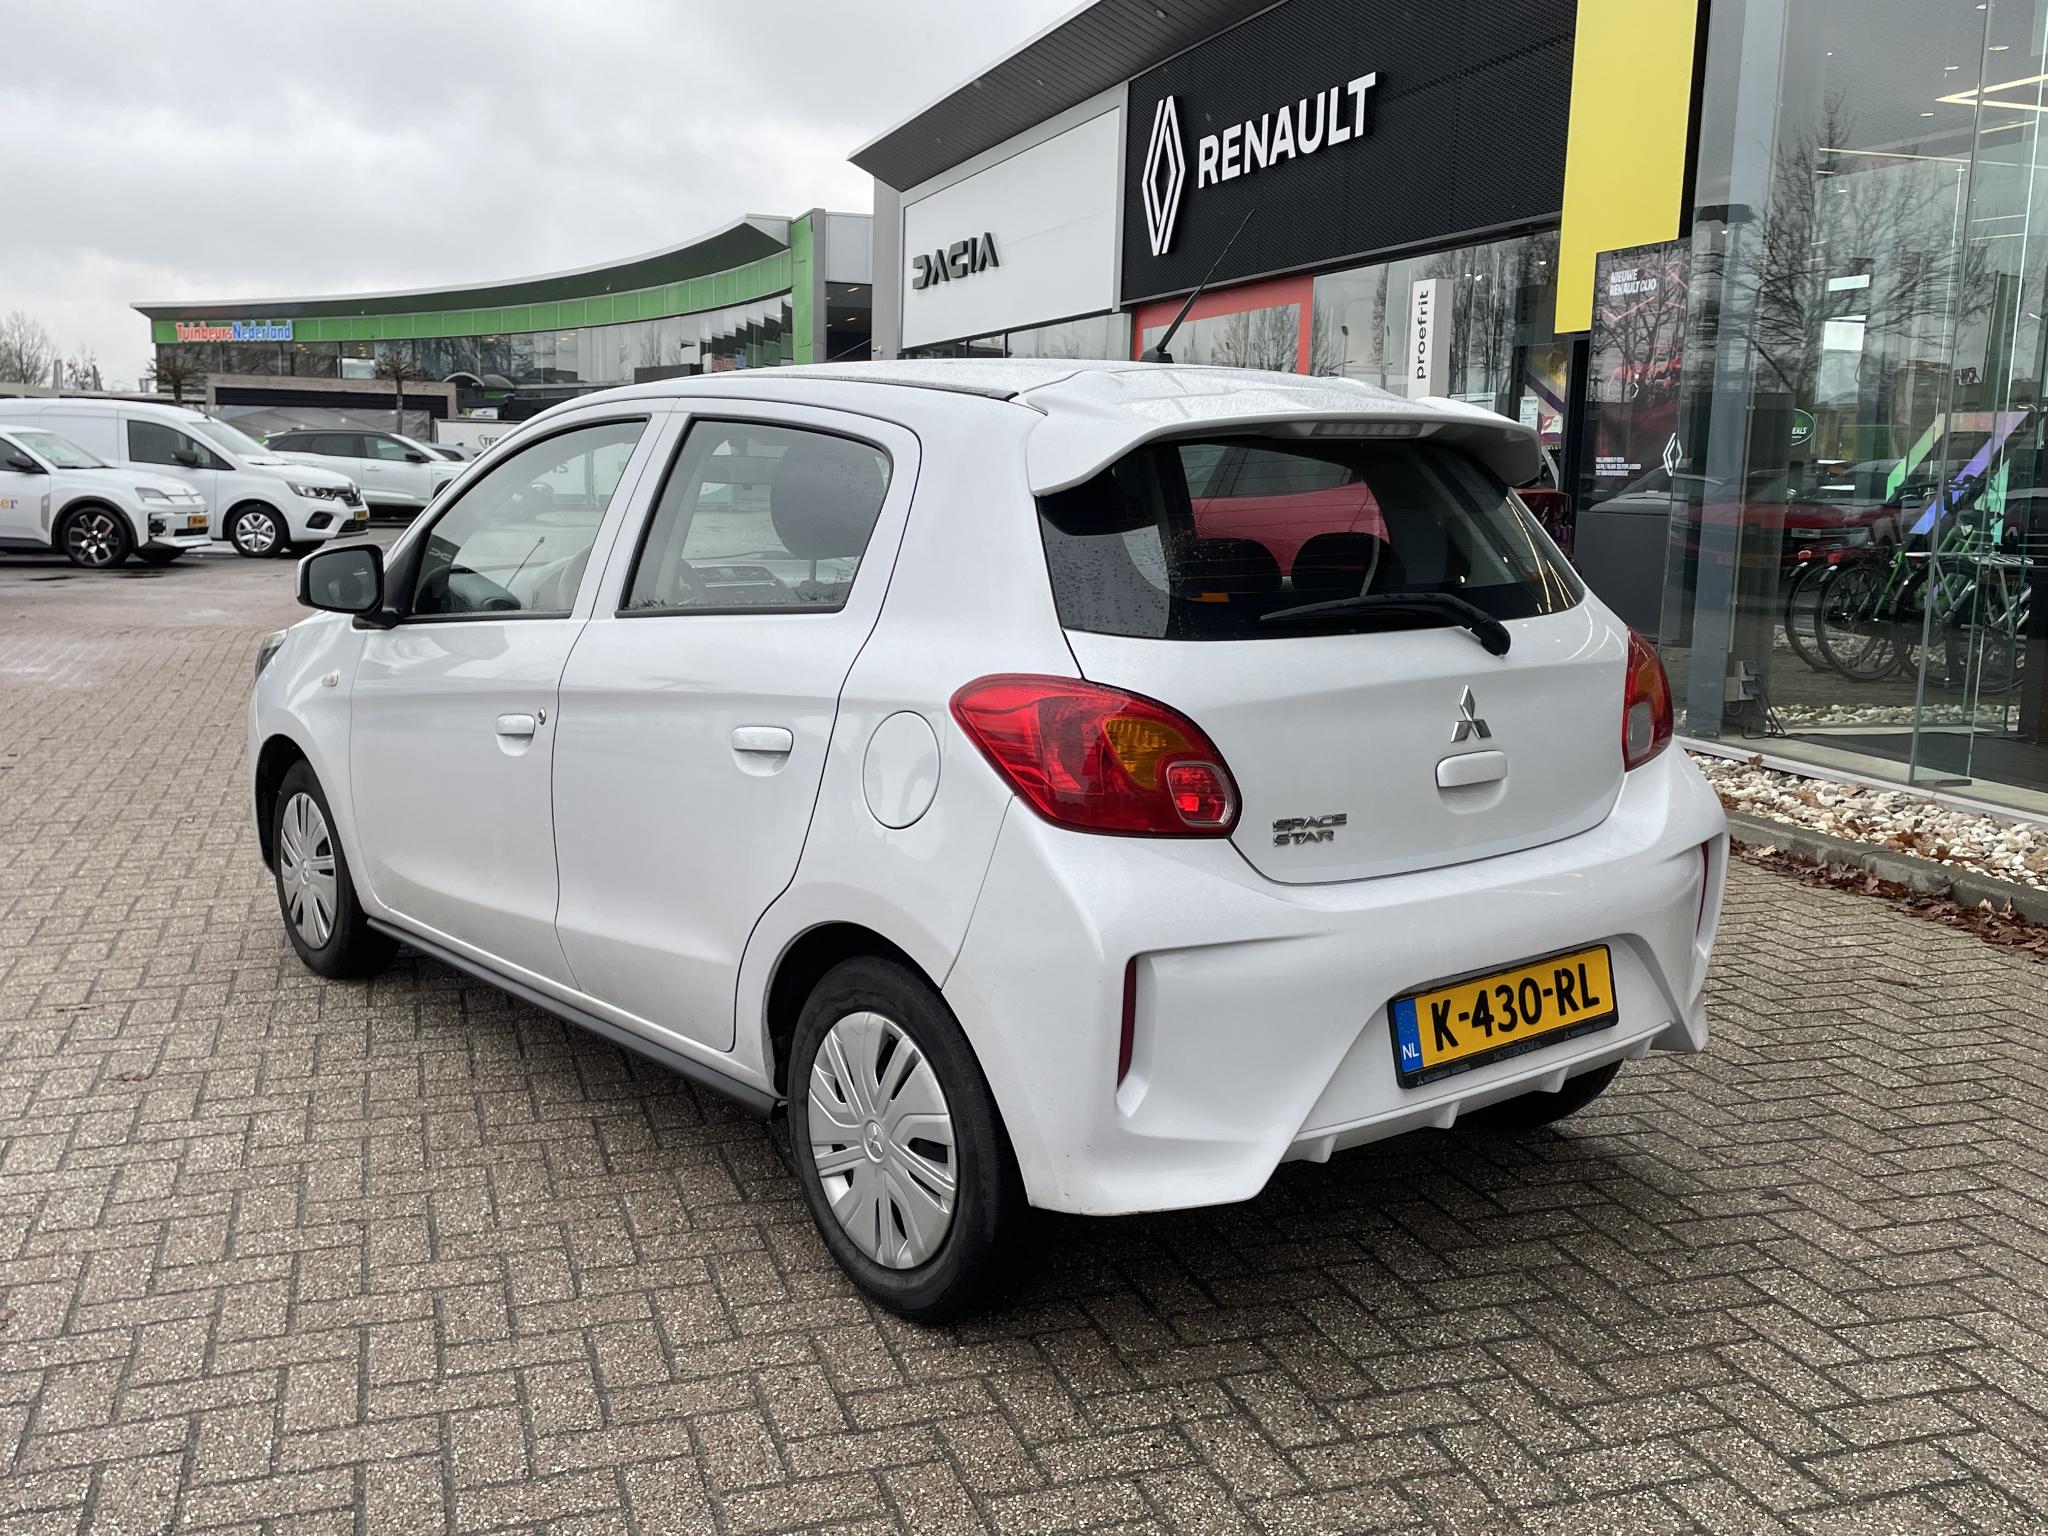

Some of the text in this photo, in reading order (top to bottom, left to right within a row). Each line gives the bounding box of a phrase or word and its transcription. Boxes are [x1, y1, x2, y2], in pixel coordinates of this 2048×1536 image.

[1198, 71, 1376, 189] RENAULT
[912, 231, 999, 290] DACIA
[1611, 268, 1639, 284] NIEUWE
[1609, 278, 1657, 297] RENAULT CLIO
[1416, 290, 1429, 380] proefrit
[1273, 813, 1347, 831] SPACE
[1273, 830, 1334, 847] STAR
[1430, 962, 1600, 1052] K-430-RL
[1402, 1042, 1420, 1061] NL
